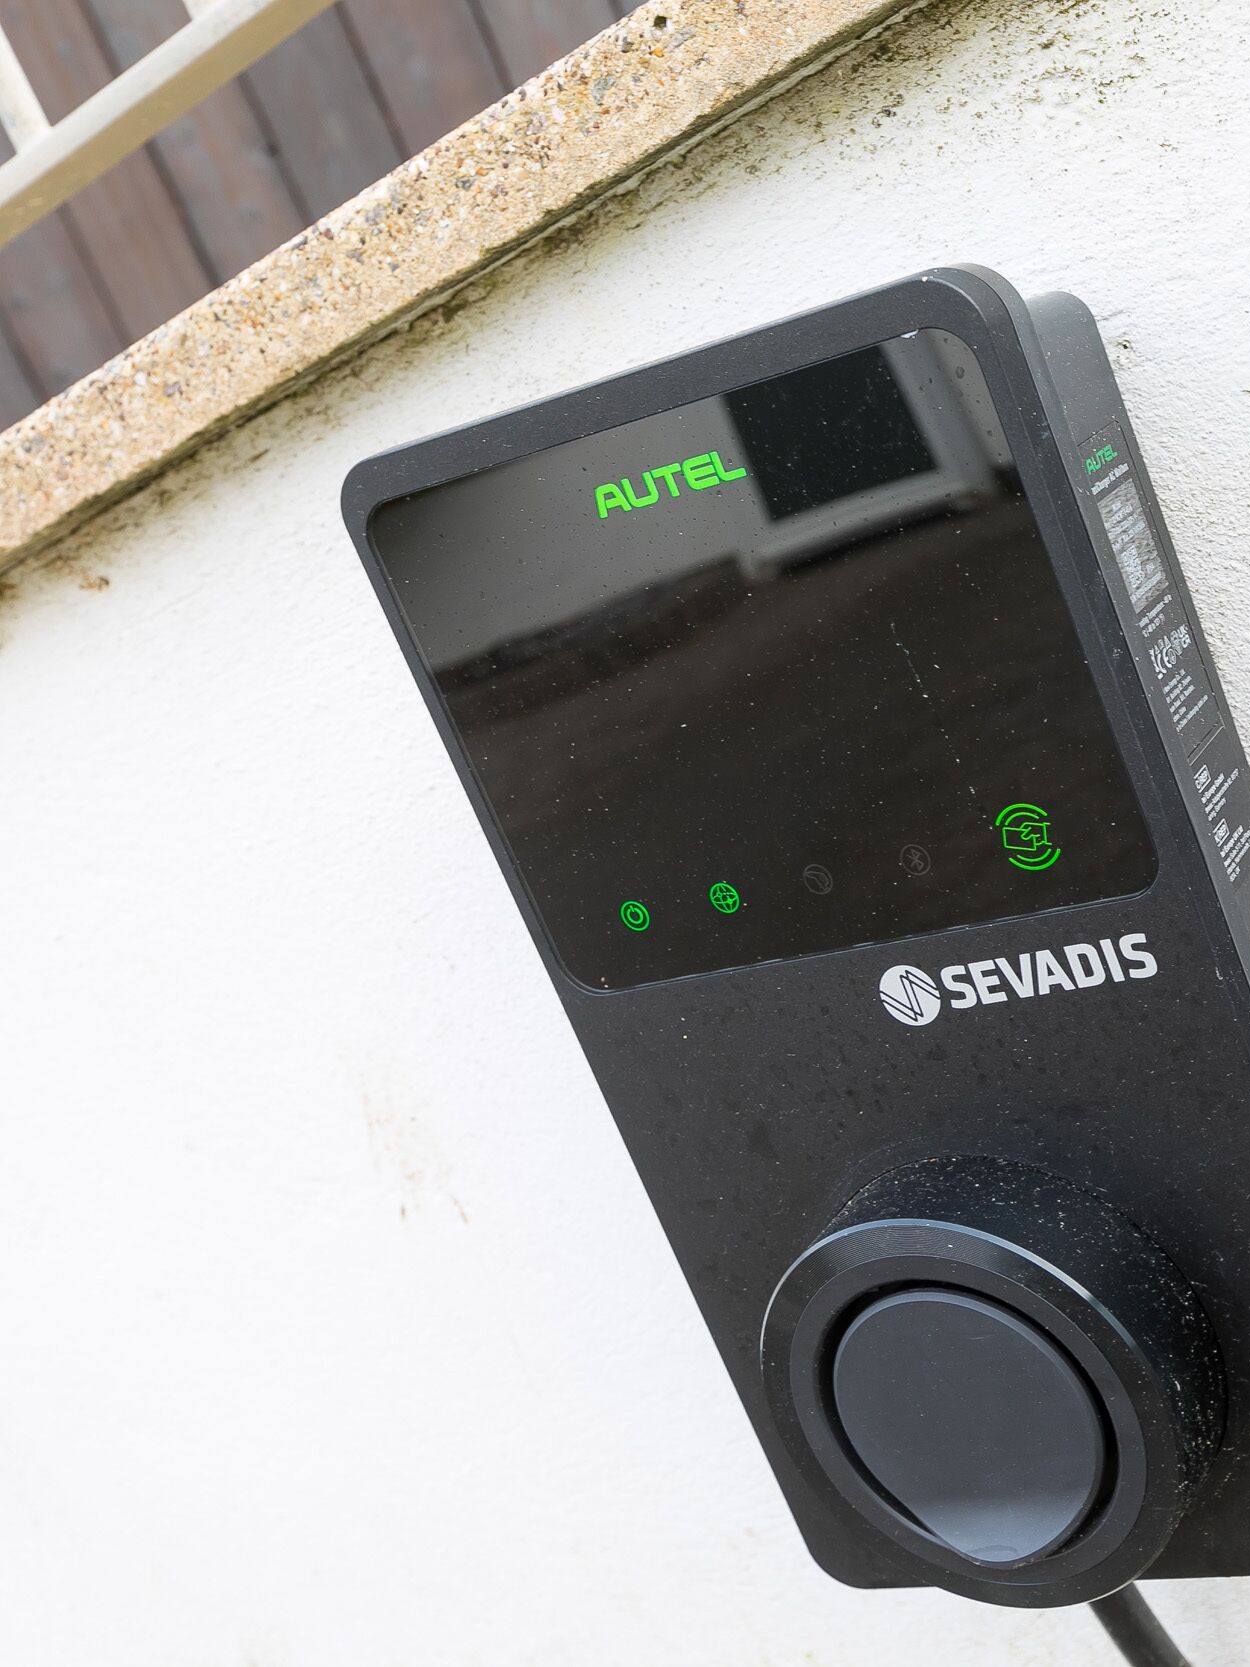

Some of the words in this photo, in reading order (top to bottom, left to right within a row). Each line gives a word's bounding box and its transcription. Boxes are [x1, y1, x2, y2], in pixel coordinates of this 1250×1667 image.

[594, 451, 749, 521] AUTEL
[1085, 445, 1119, 476] AUTEL
[940, 933, 1159, 1010] SEVADIS
